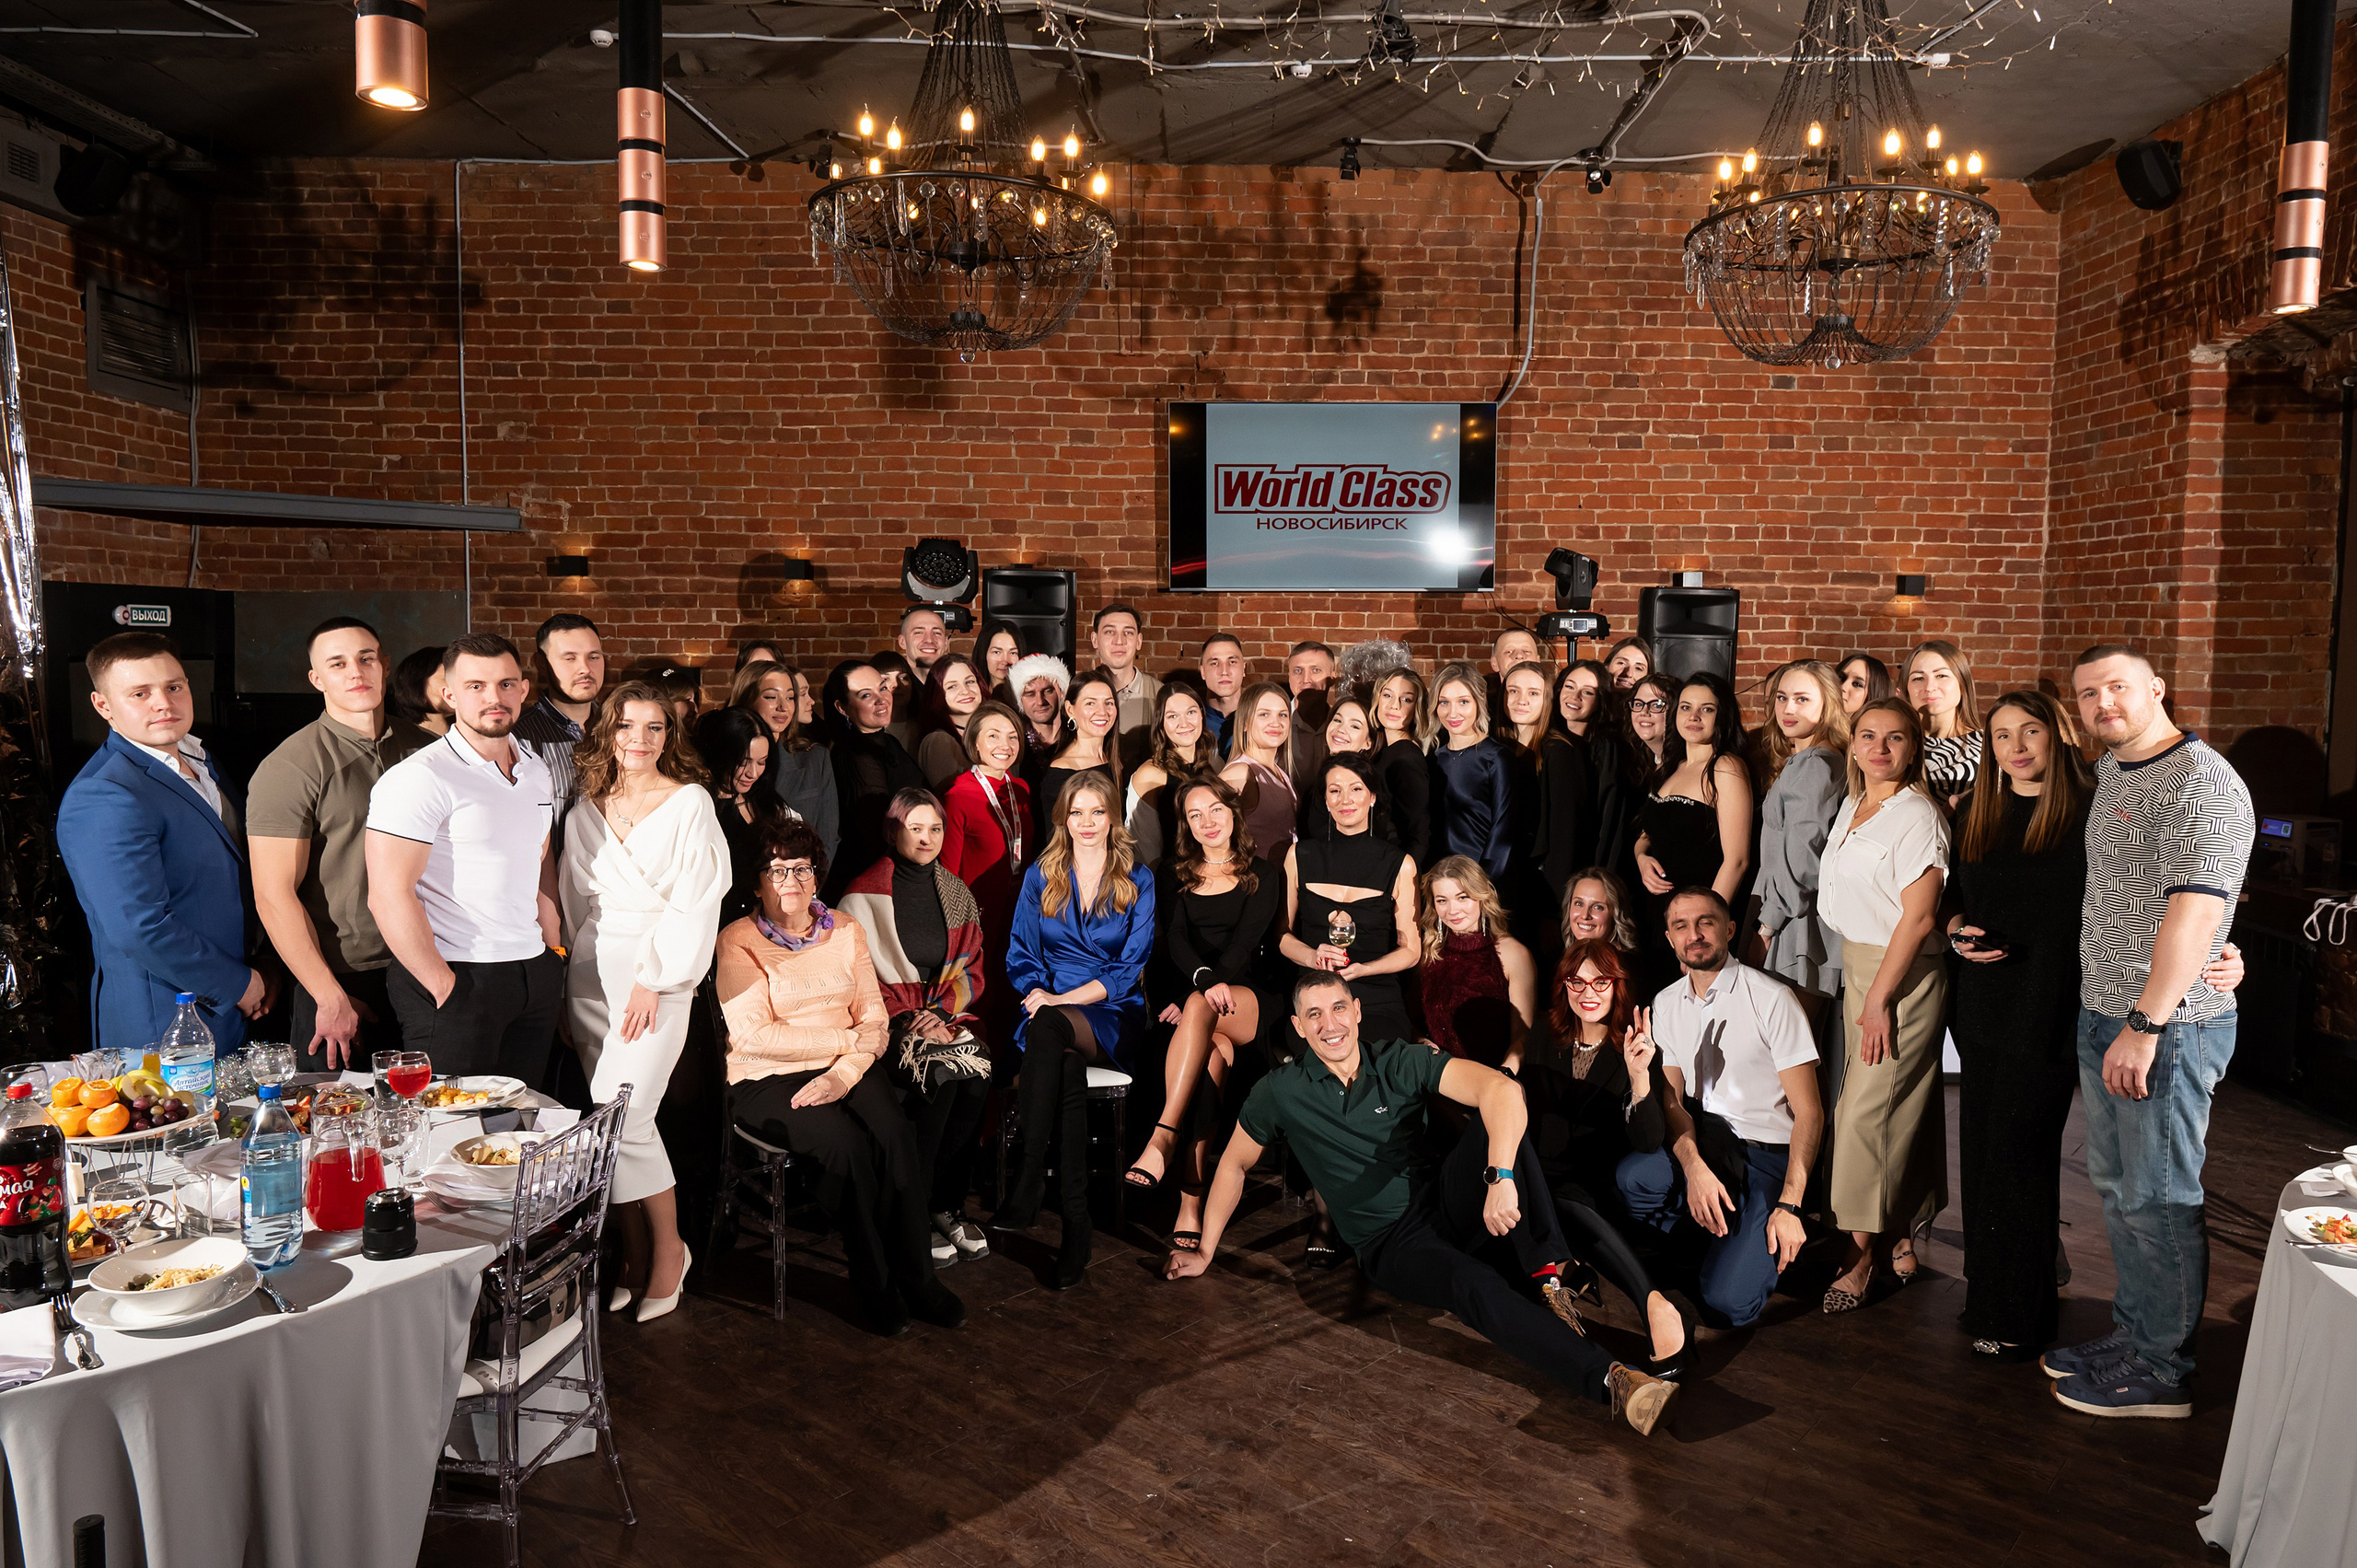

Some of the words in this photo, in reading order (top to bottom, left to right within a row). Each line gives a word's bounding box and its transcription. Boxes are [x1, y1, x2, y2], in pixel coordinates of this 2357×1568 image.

[1224, 470, 1335, 507] World
[1339, 470, 1443, 507] Class
[1256, 517, 1409, 530] НОВОСИБИРСК
[132, 610, 166, 621] ВЫХОД
